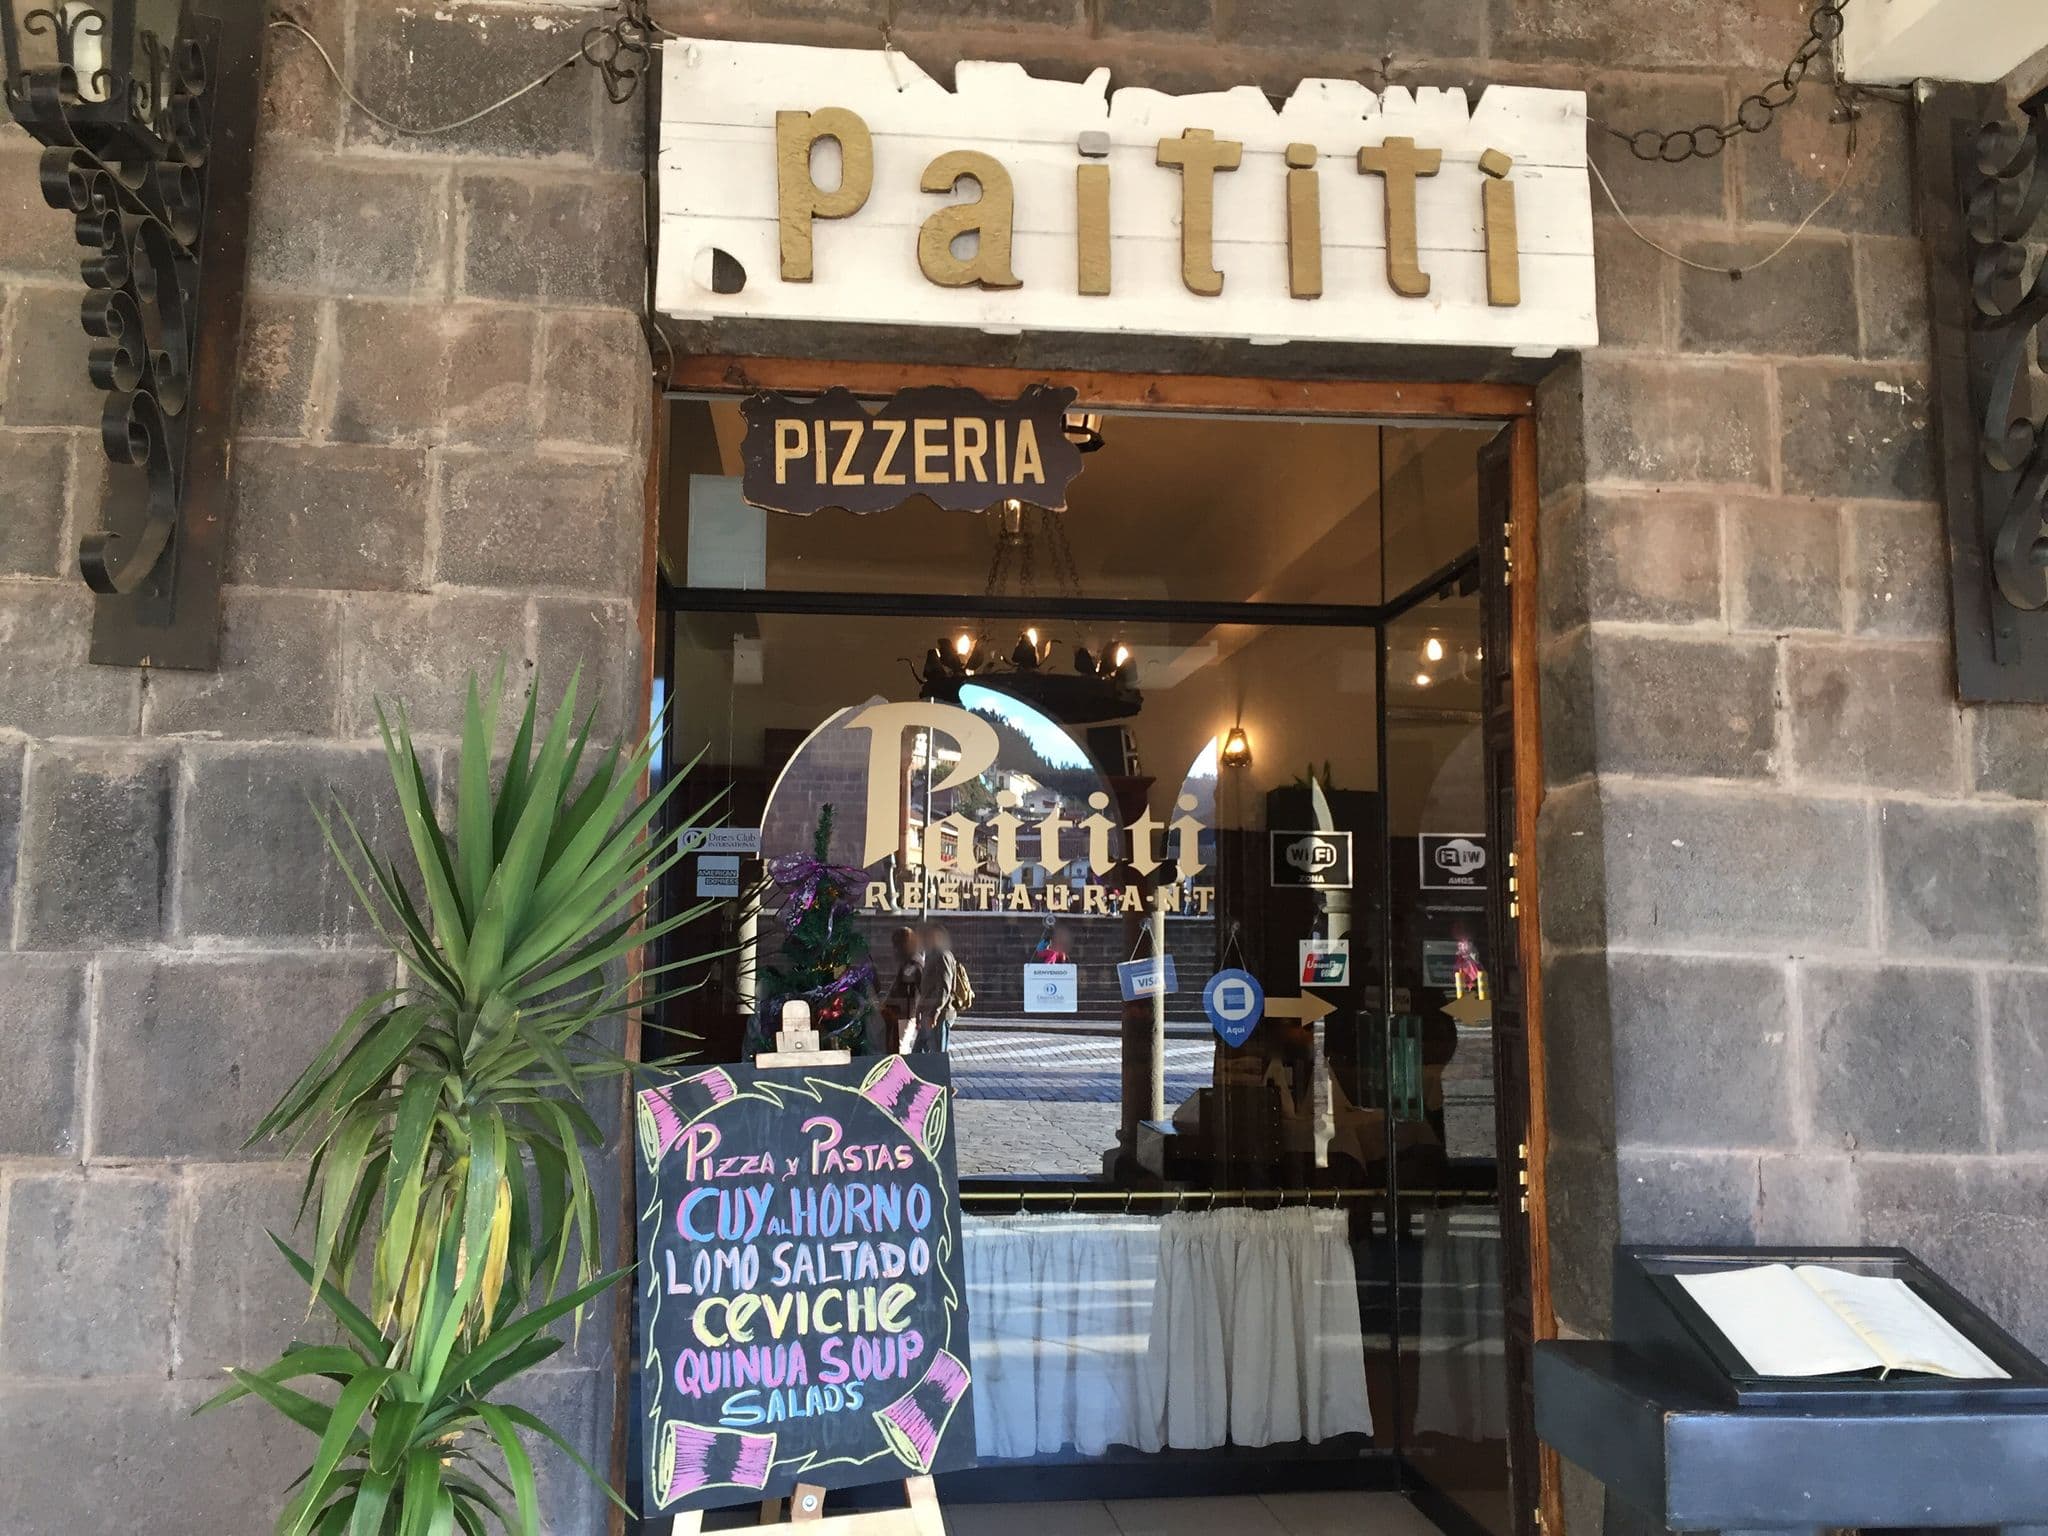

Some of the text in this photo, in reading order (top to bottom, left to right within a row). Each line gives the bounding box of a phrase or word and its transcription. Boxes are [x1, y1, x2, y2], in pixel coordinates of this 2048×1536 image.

[774, 416, 1046, 486] PIZZERIA
[843, 702, 1207, 877] Paititi
[736, 832, 756, 841] Club
[698, 869, 738, 877] AMERICAN
[704, 877, 739, 886] EXPRESS
[676, 1181, 933, 1243] CUY AL HORNO
[665, 1236, 930, 1296] LOMO SALTADO
[818, 1329, 925, 1384] SOUP
